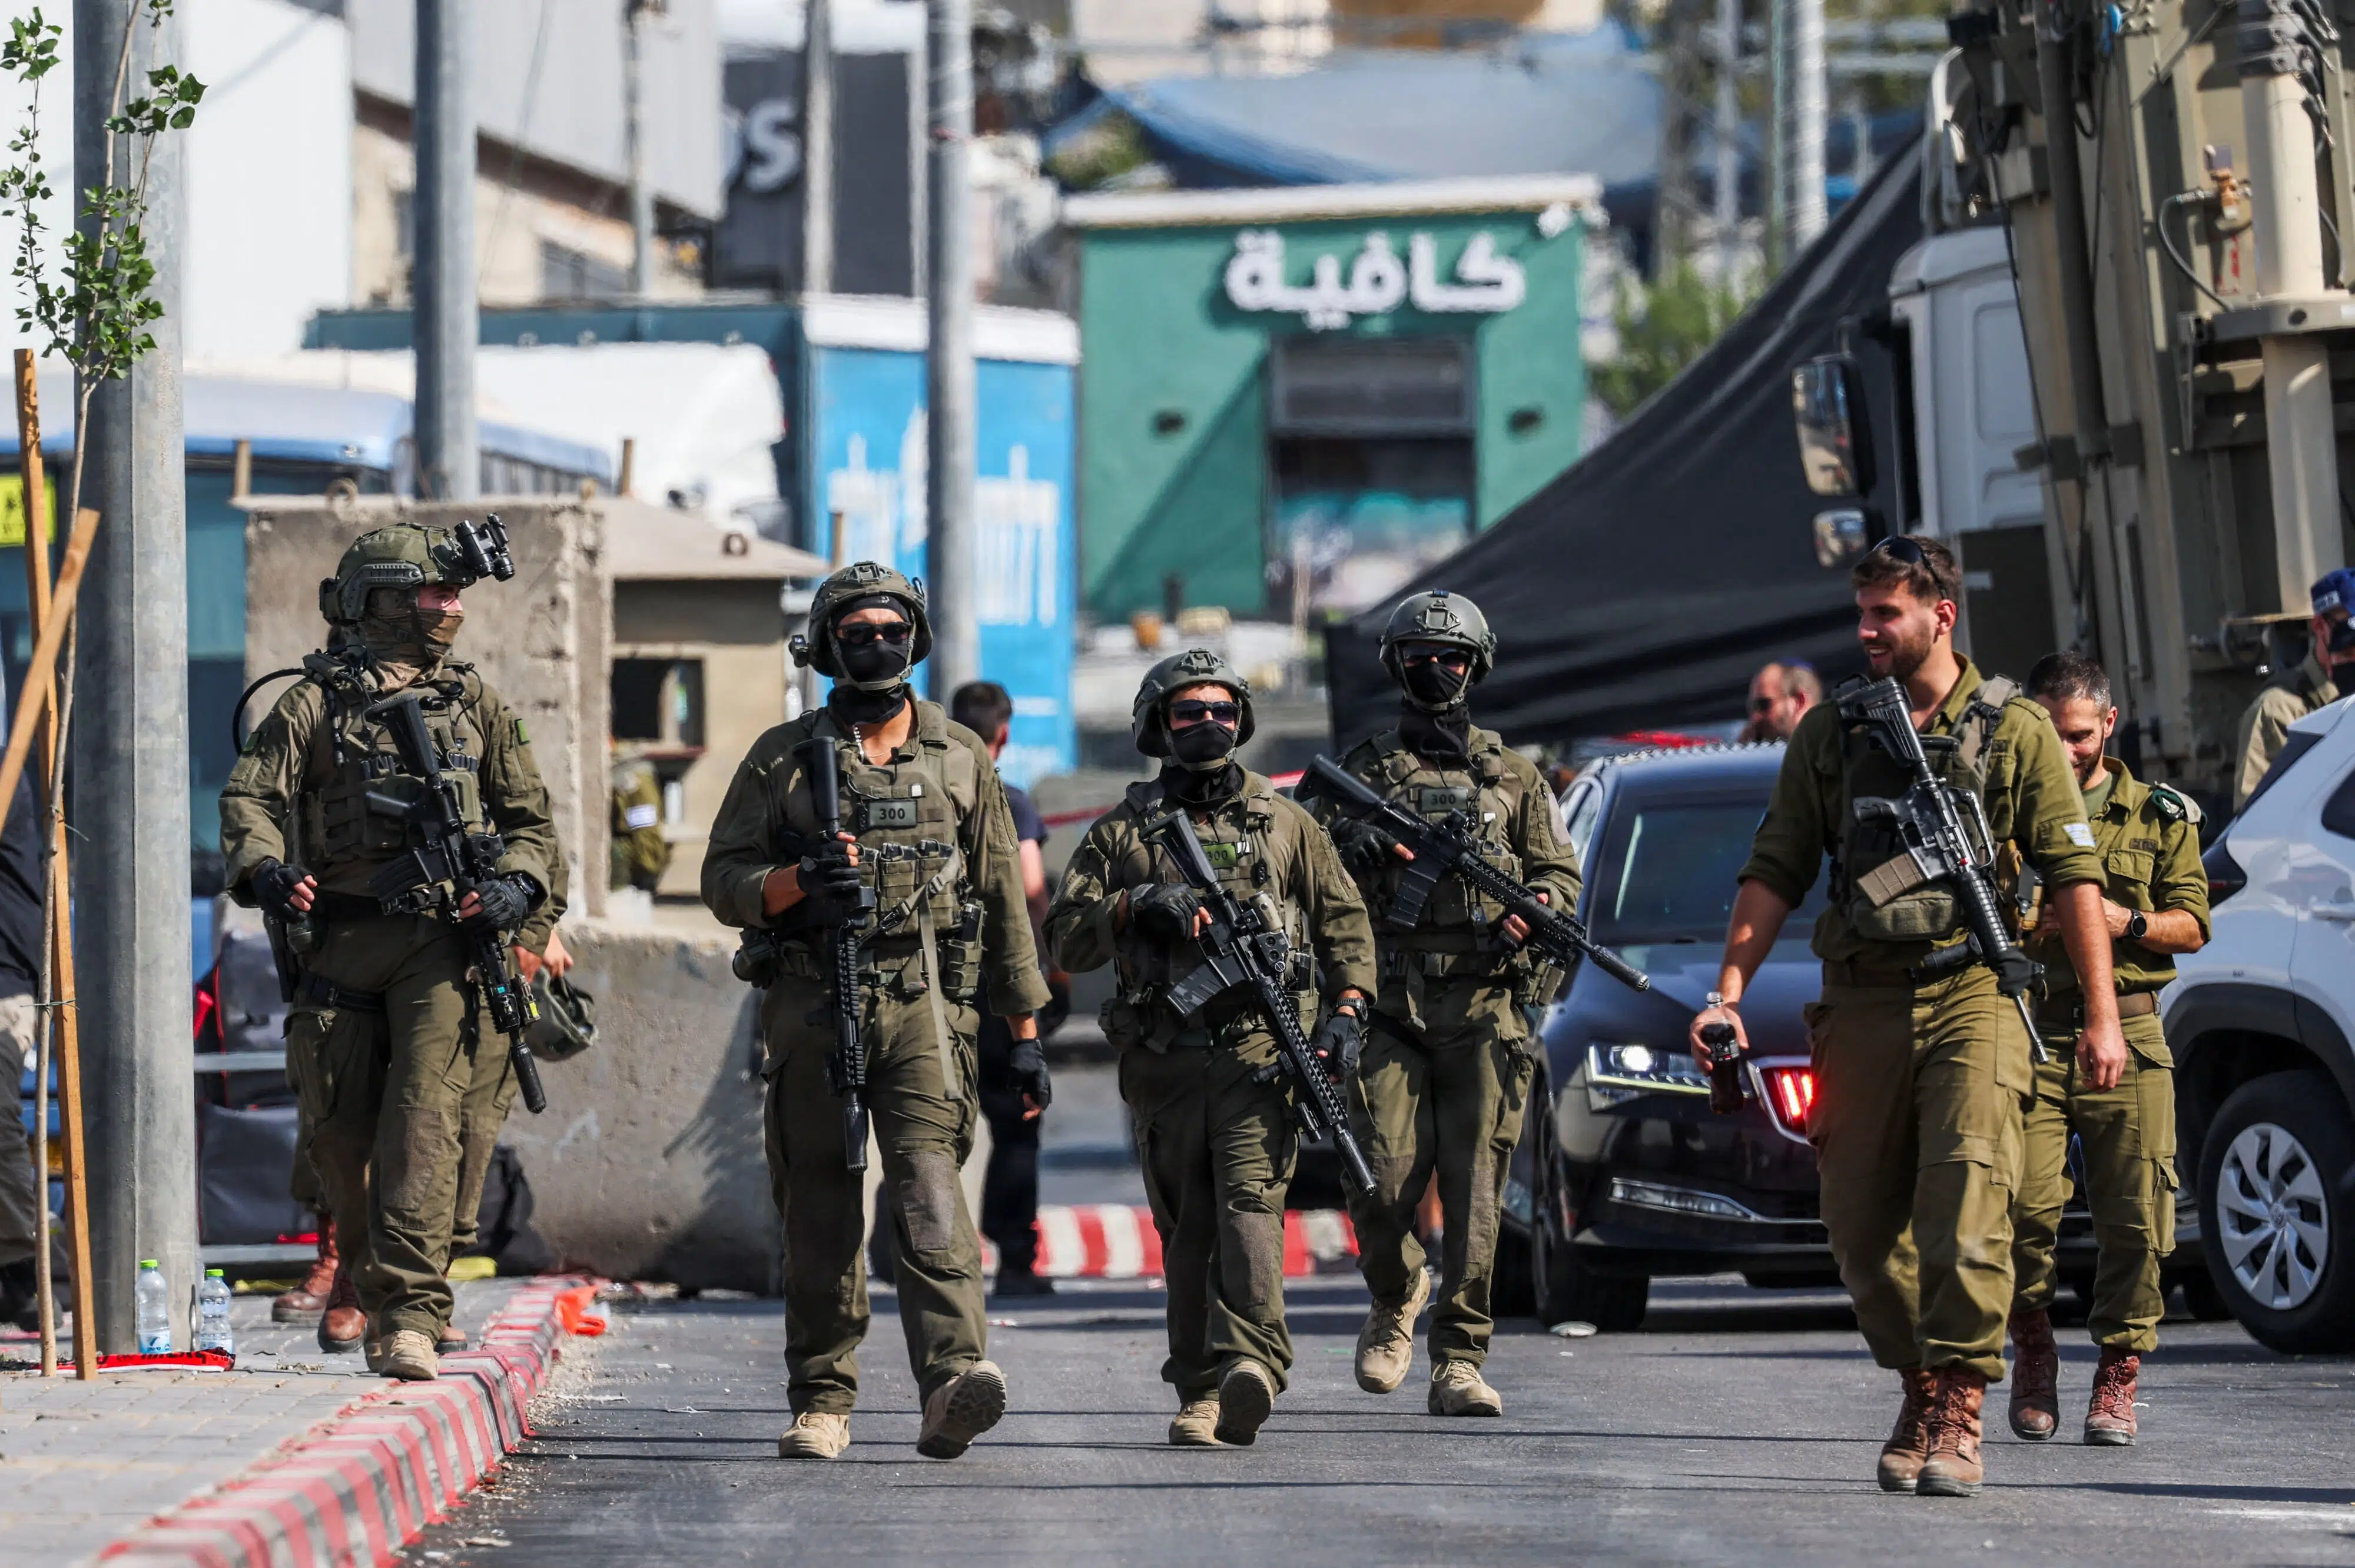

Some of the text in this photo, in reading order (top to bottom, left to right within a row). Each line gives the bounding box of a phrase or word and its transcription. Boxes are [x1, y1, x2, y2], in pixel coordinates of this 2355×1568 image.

[1224, 228, 1525, 333] كافية
[1431, 793, 1456, 805] 300
[879, 808, 905, 820] 300
